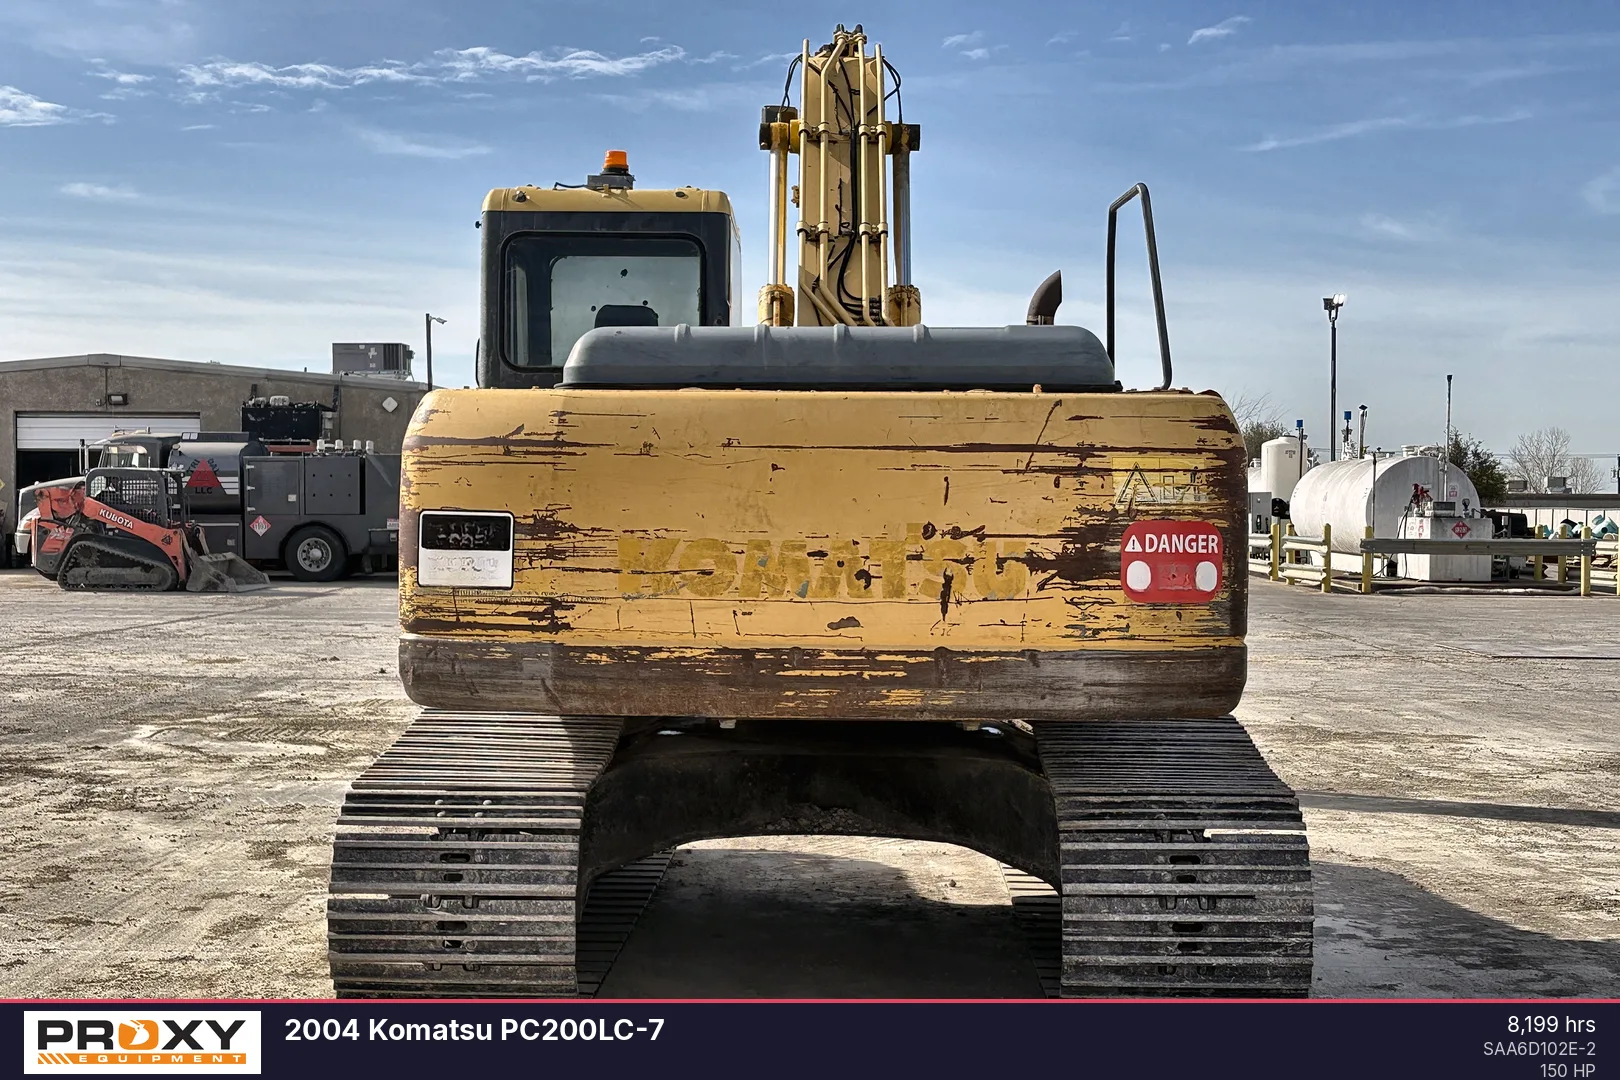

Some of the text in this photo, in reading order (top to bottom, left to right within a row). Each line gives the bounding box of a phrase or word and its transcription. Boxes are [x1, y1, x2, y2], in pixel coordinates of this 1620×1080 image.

[195, 487, 213, 495] LLC
[99, 508, 133, 529] KUBOTA
[1145, 533, 1219, 554] DANGER
[617, 524, 1028, 599] KOMATSU
